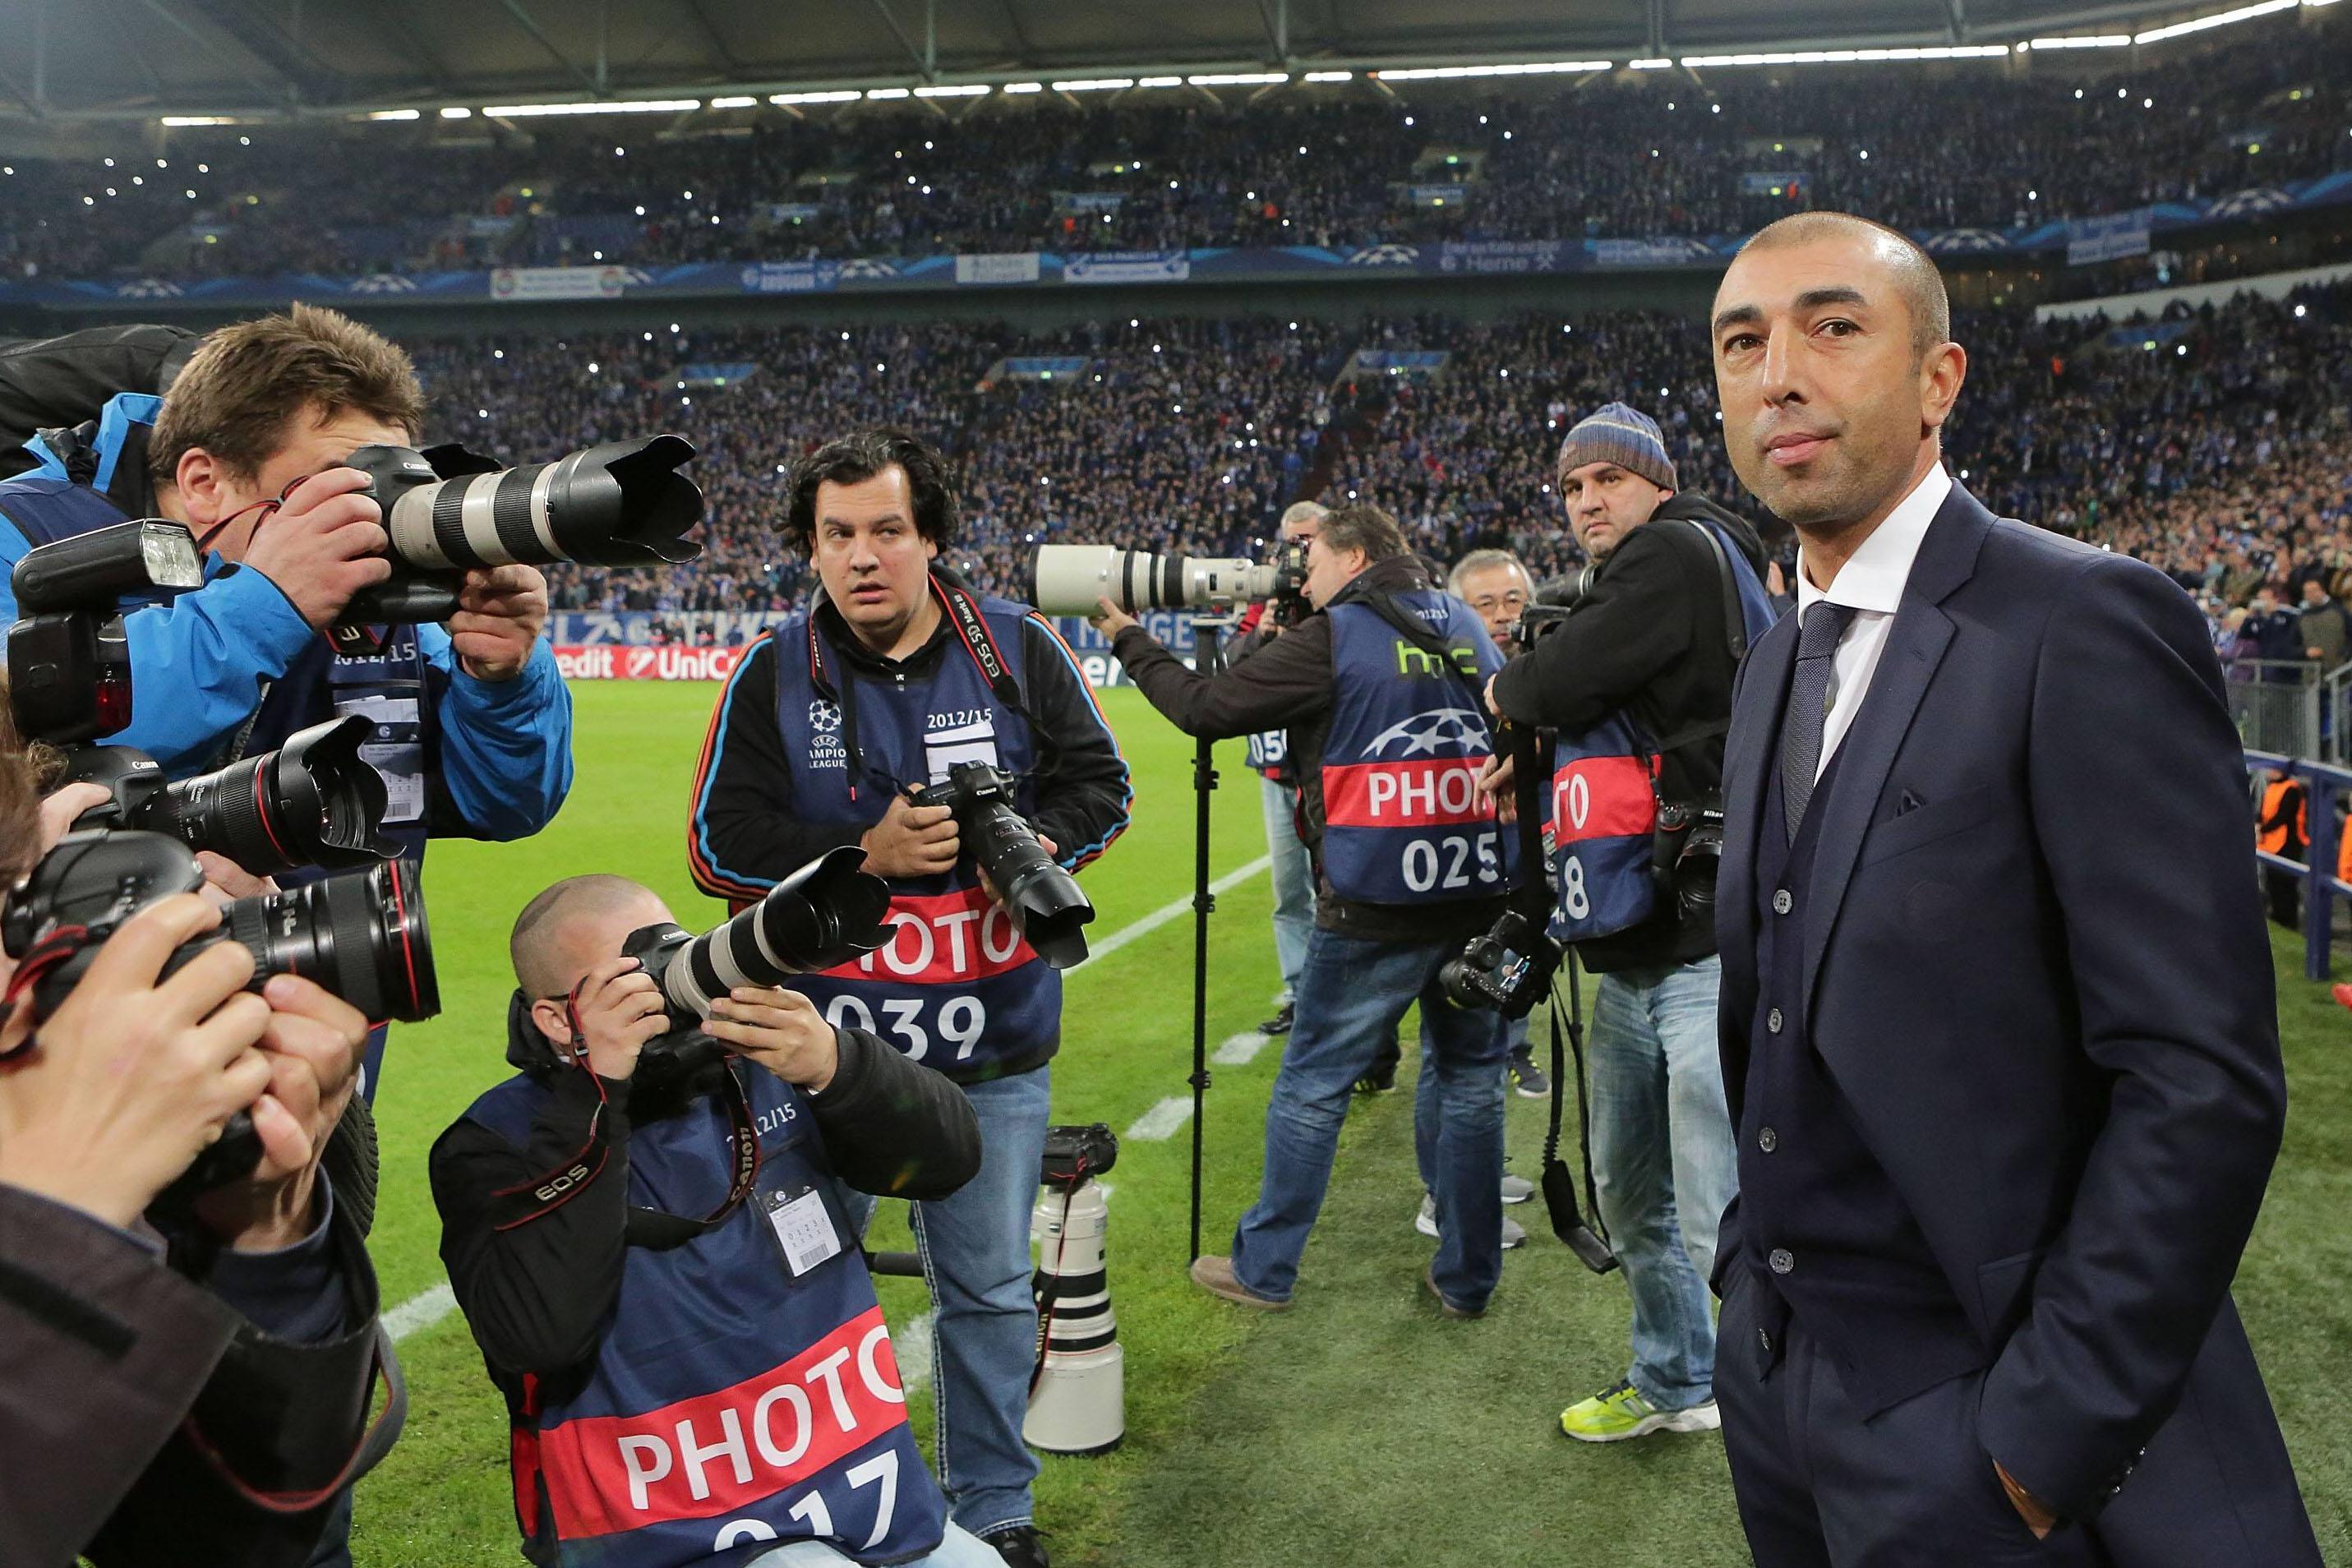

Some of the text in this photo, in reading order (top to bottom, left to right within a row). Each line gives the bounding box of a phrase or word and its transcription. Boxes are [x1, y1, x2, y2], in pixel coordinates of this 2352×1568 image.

[403, 462, 430, 470] Canon
[967, 625, 984, 643] 5D
[977, 643, 1000, 678] EOS
[926, 708, 994, 730] 2012/15
[812, 736, 838, 748] UEFA
[1249, 728, 1288, 764] 05
[809, 759, 847, 769] LEAGUE
[976, 786, 997, 796] Canon
[1703, 809, 1724, 819] Nikon
[1402, 832, 1499, 892] 025
[826, 994, 986, 1061] 039
[534, 1164, 589, 1201] EOS
